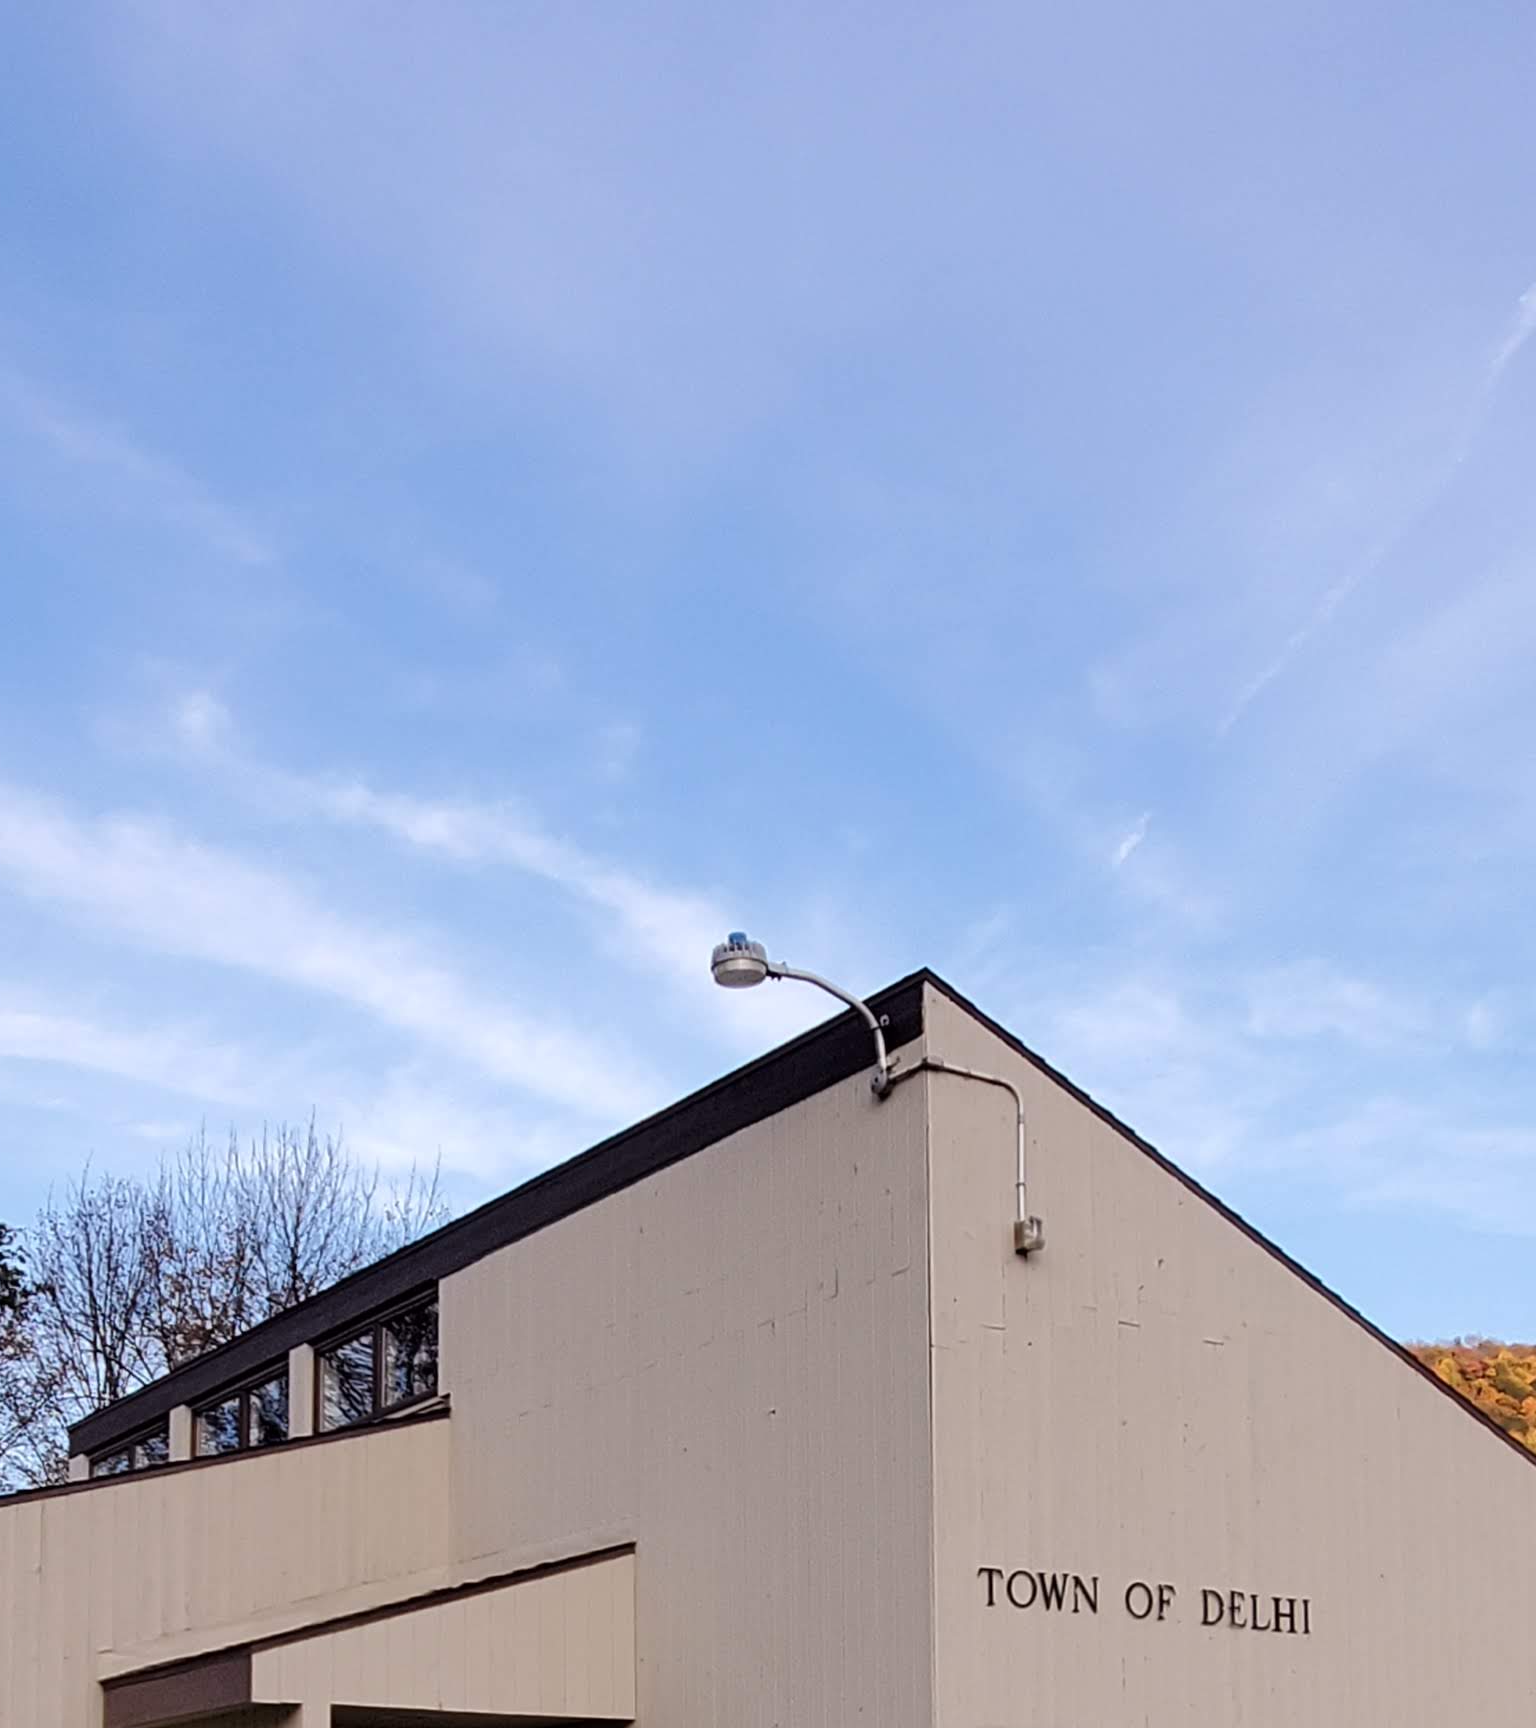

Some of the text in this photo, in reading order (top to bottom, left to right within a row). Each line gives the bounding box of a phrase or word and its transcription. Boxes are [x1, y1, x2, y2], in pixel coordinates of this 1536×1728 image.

[977, 1567, 1311, 1634] TOWN OF DELHI
